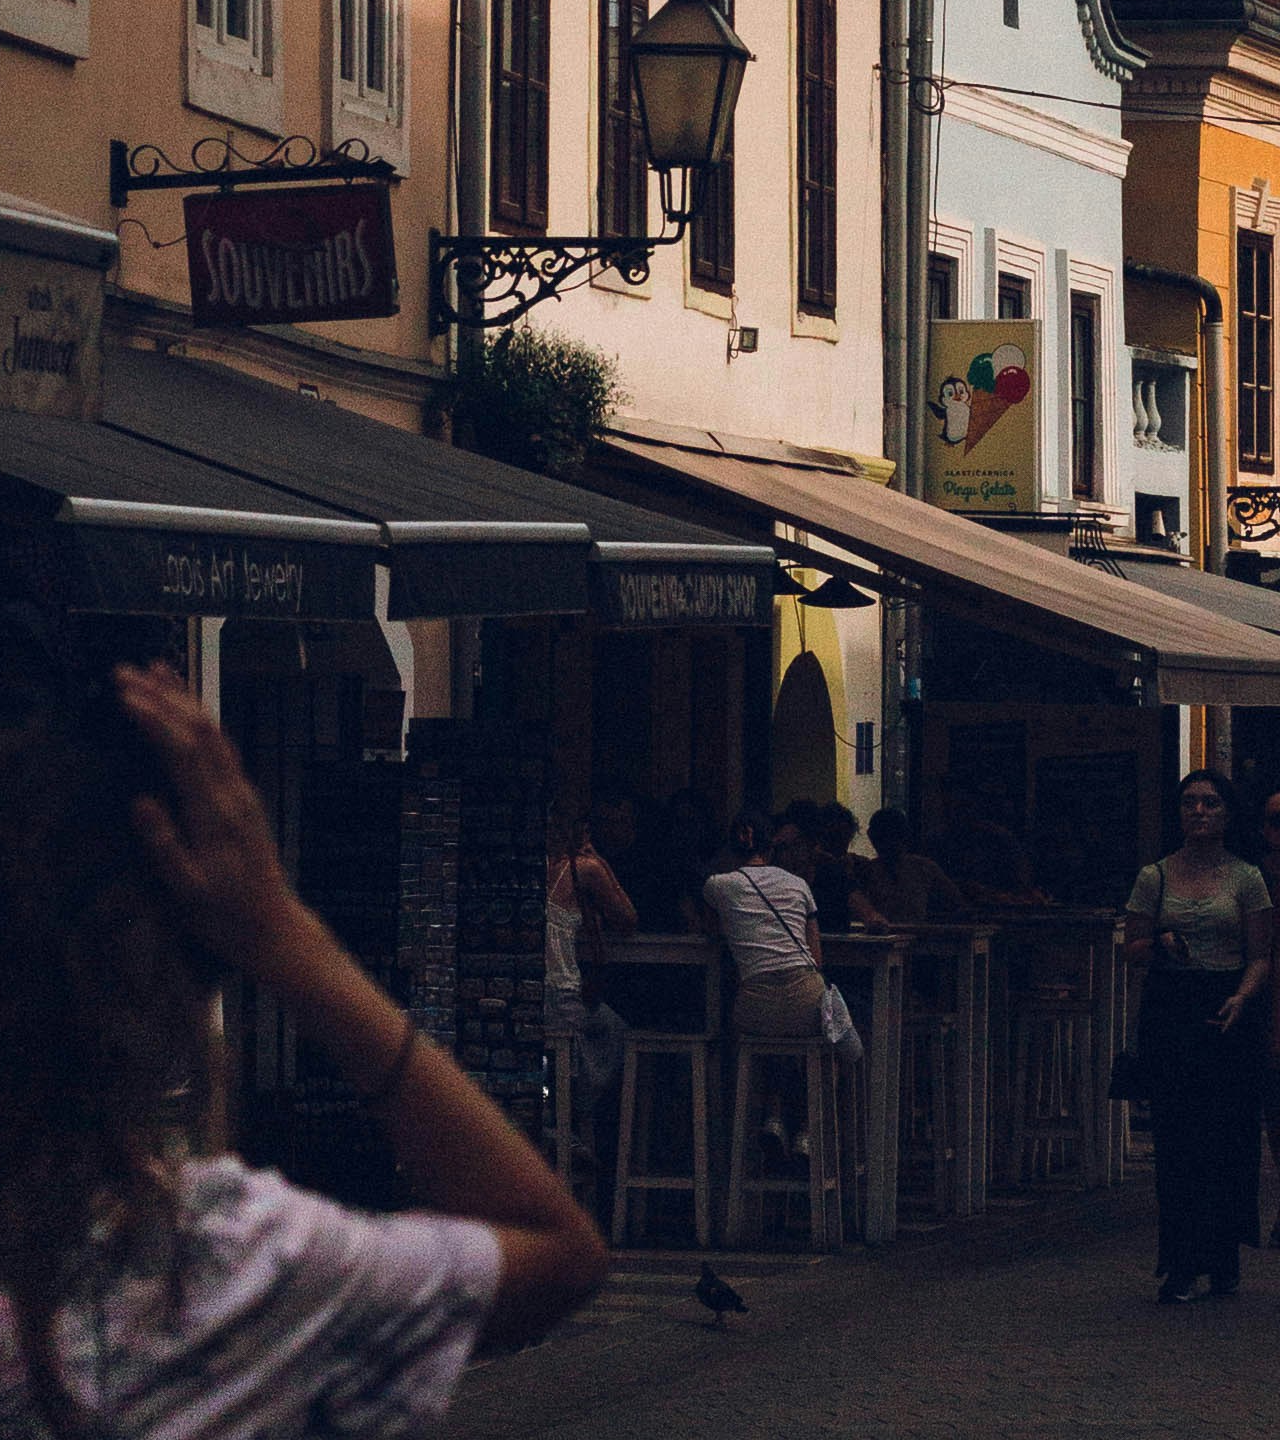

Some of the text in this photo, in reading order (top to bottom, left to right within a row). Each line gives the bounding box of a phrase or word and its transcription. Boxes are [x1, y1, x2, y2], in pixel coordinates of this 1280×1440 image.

[201, 219, 373, 309] SOUVENIRS
[943, 481, 977, 503] Pingu
[241, 548, 304, 614] Jewelry
